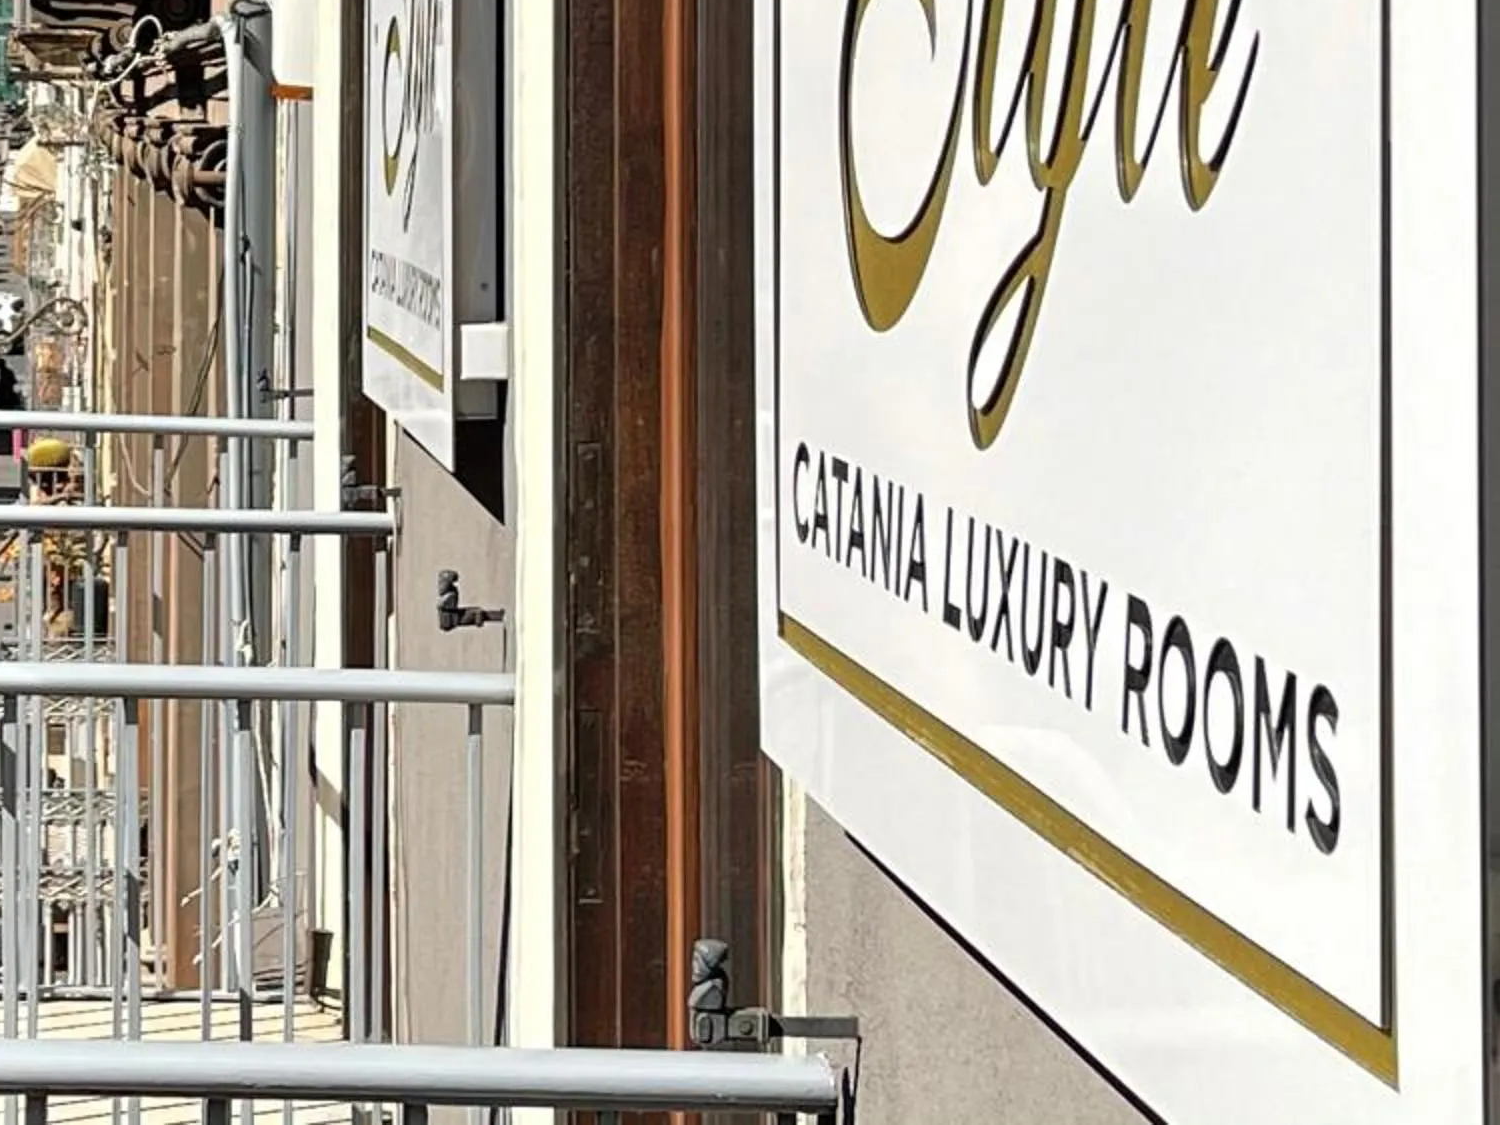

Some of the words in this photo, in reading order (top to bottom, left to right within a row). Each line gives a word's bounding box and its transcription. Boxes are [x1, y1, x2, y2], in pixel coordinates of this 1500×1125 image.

[791, 440, 929, 613] CATANIA
[943, 505, 1109, 713] LUXURY
[1122, 590, 1342, 857] ROOMS
